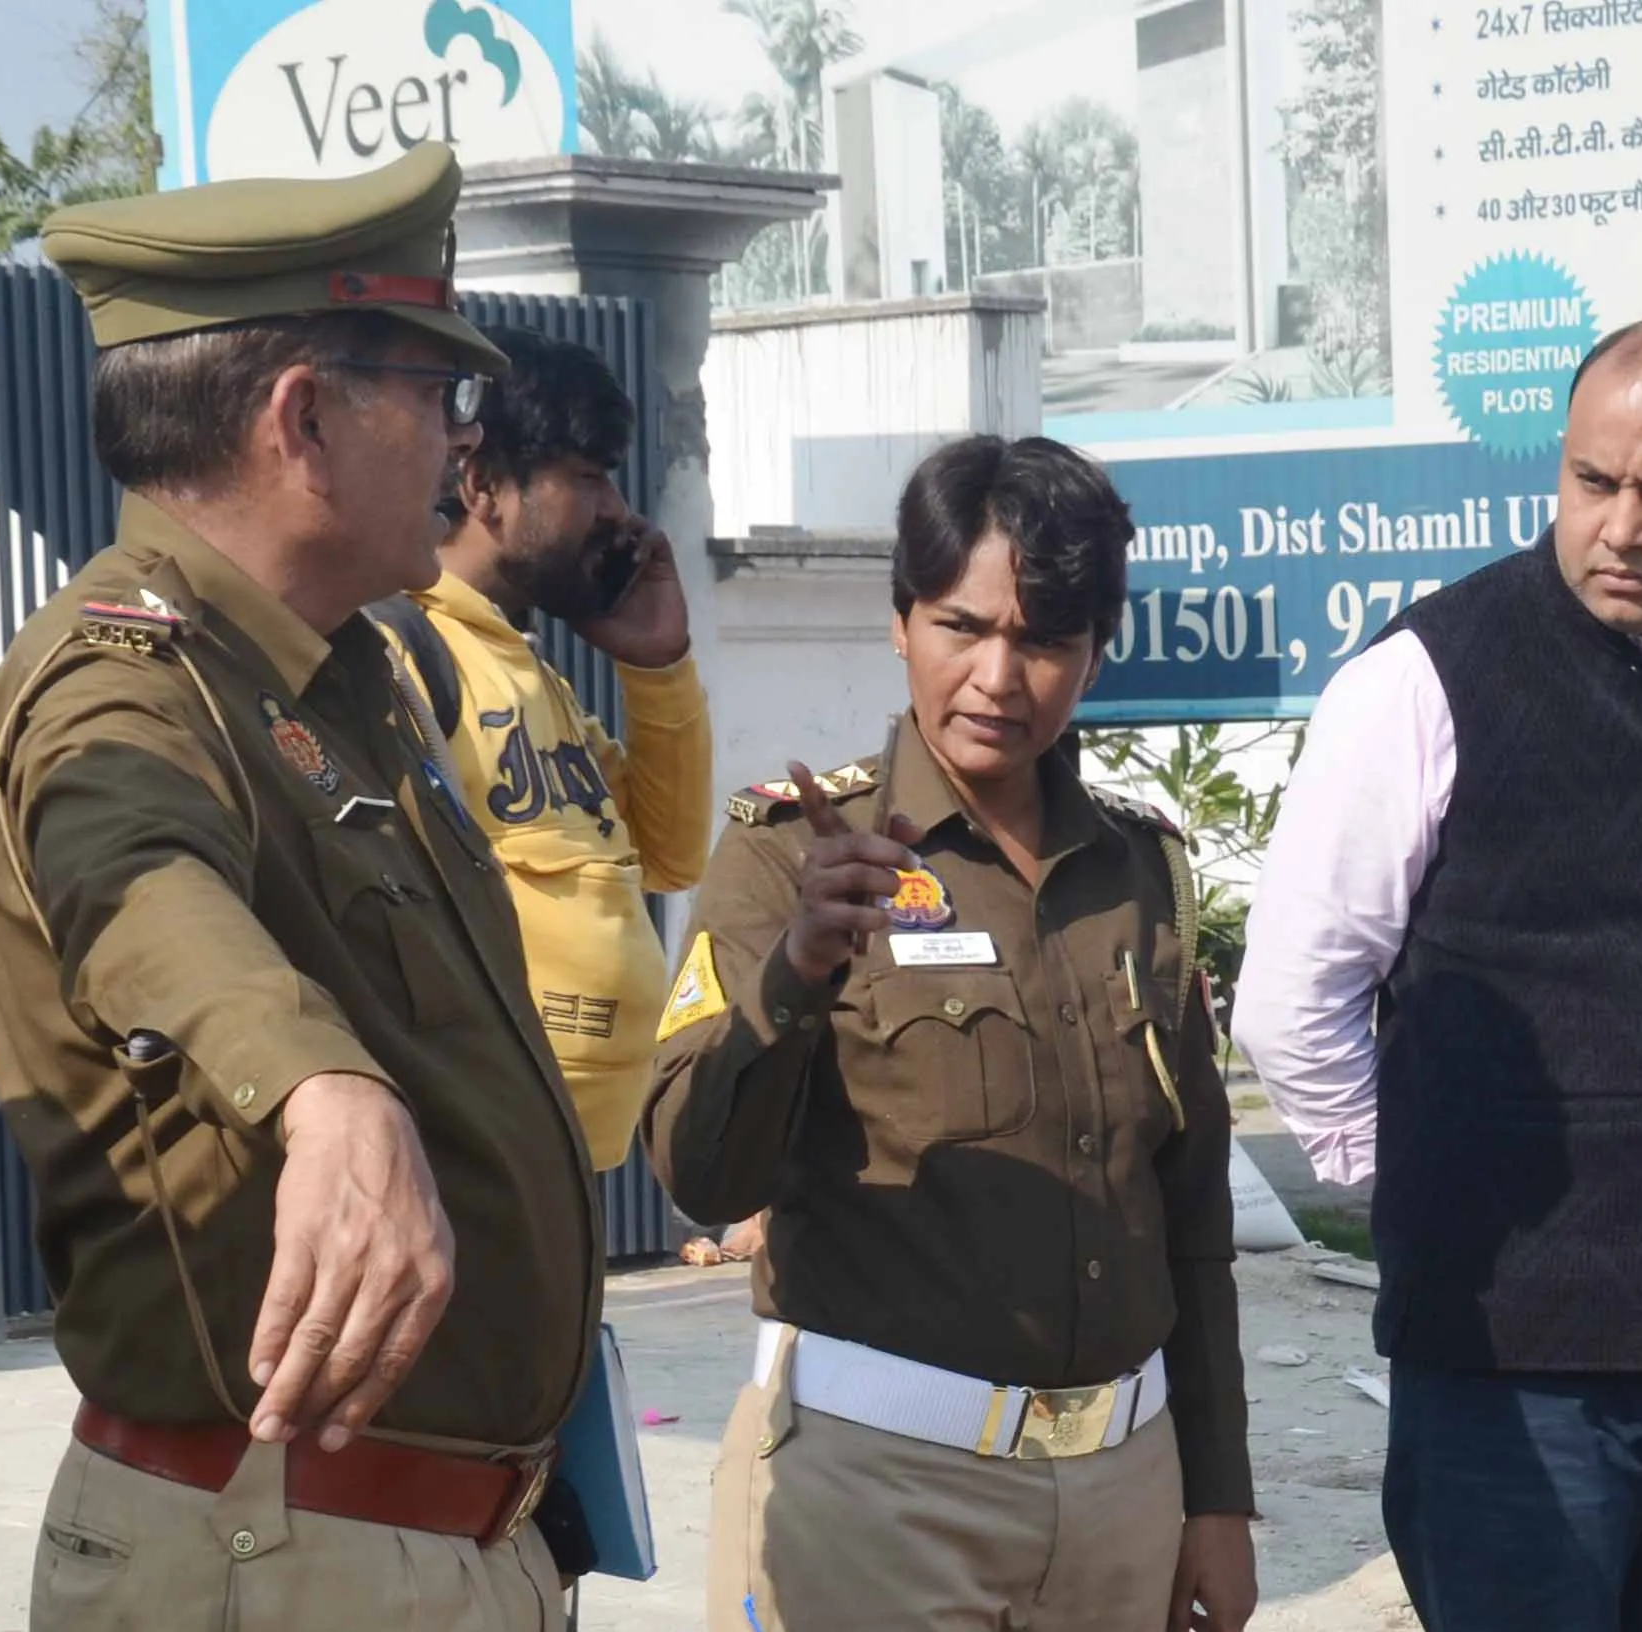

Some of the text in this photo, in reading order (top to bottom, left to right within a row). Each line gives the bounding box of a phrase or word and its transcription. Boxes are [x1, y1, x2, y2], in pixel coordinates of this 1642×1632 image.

[1476, 5, 1534, 39] 24x7
[277, 53, 469, 167] Veer
[1477, 198, 1501, 223] 40
[1506, 188, 1550, 221] और
[1552, 193, 1577, 217] 30
[1452, 297, 1582, 335] PREMIUM
[1446, 344, 1582, 377] RESIDENTIAL
[1482, 386, 1555, 415] PLOTS
[1126, 523, 1229, 574] ump,
[1238, 505, 1327, 557] Dist
[1338, 496, 1493, 553] Shamli
[1104, 579, 1442, 676] 01501, 97
[542, 991, 619, 1038] 23
